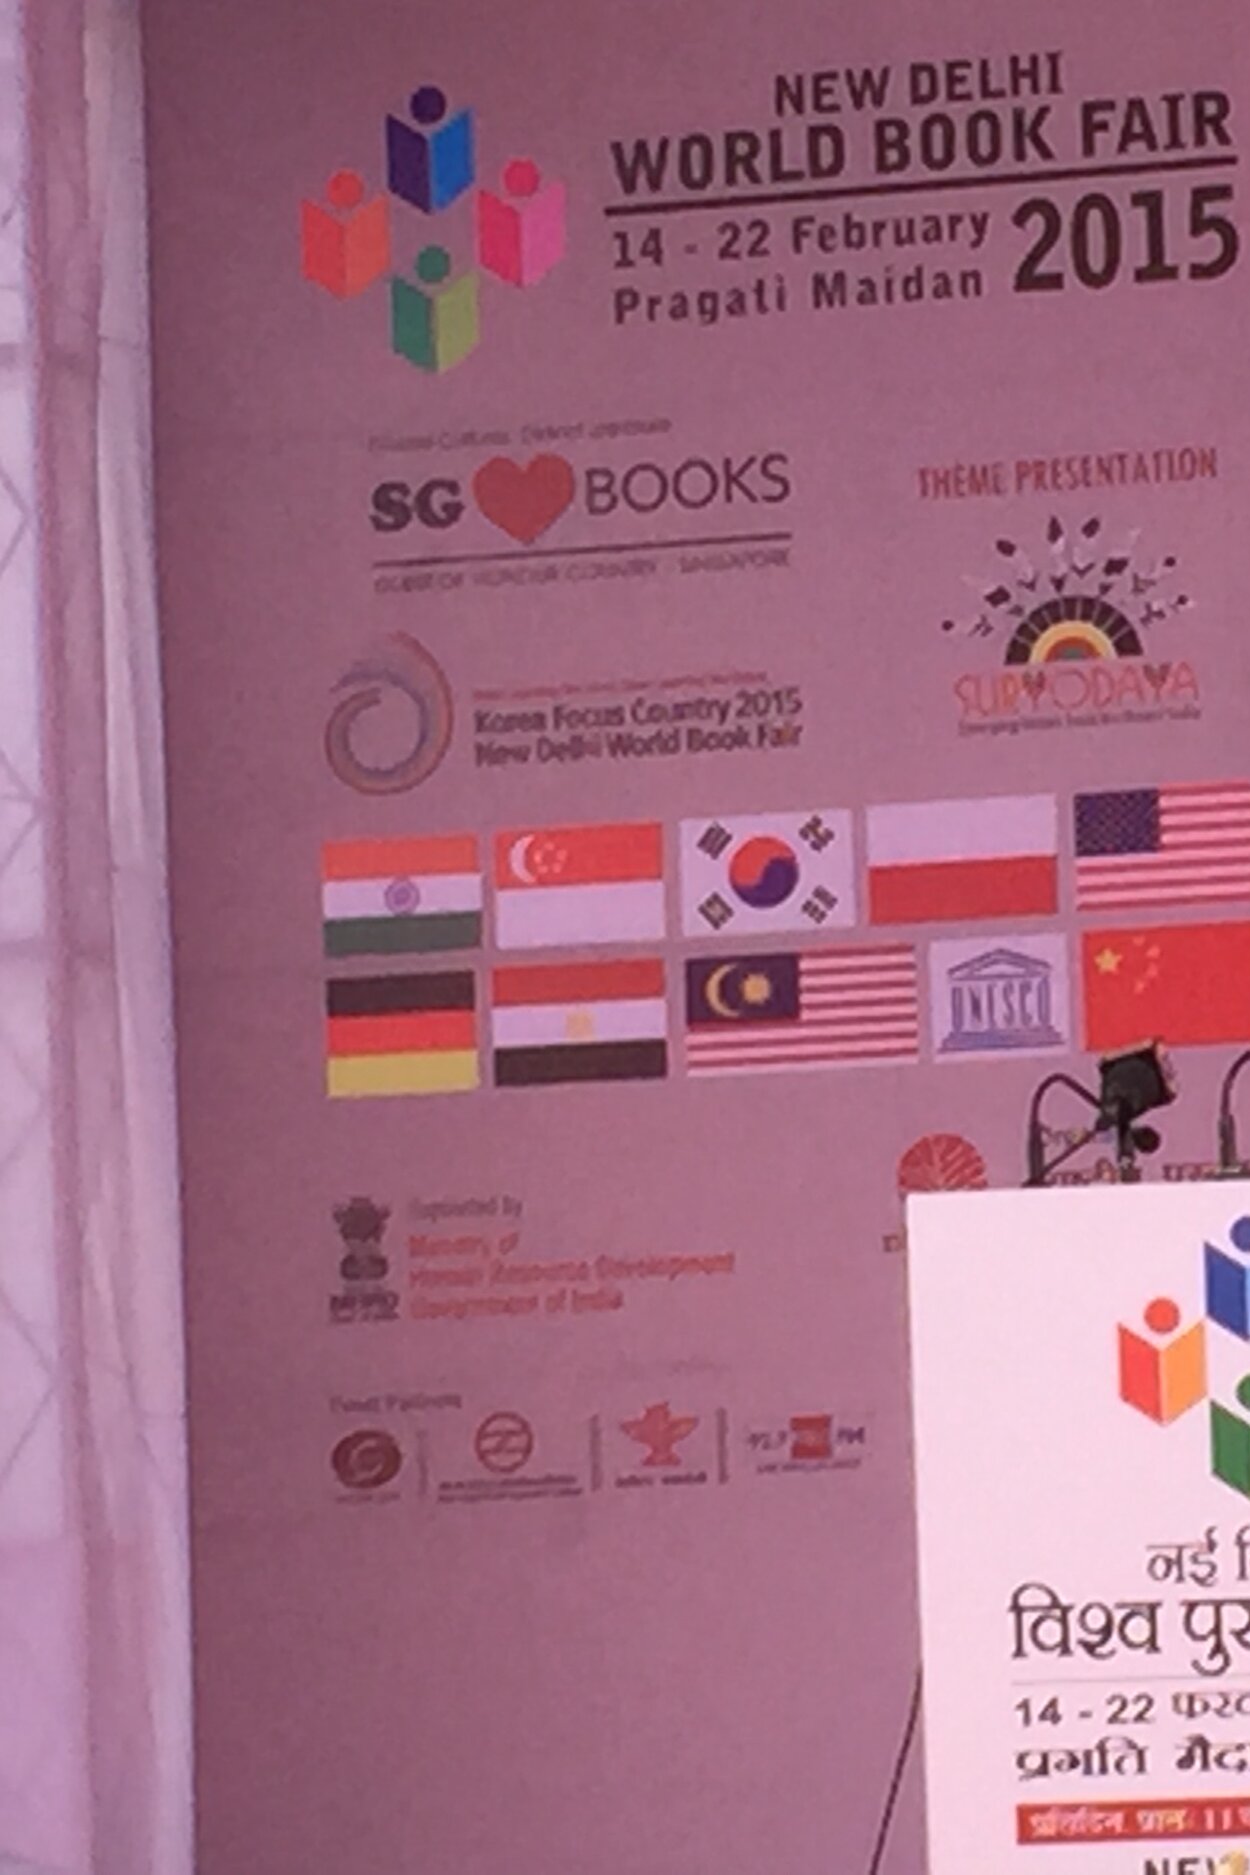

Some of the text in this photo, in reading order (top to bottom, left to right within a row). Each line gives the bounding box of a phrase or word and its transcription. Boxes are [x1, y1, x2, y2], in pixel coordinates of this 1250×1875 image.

[774, 51, 1063, 117] NEW DELHI
[610, 90, 1232, 194] WORLD BOOK FAIR
[613, 227, 664, 268] 14
[717, 219, 771, 259] 22
[791, 210, 991, 256] February
[1011, 183, 1240, 292] 2015
[614, 263, 982, 325] Pragati Maidan
[369, 452, 791, 532] SG BOOKS
[917, 447, 1218, 498] THEME PRESENTATION
[474, 687, 803, 734] Korea Focus Country 2015
[475, 722, 804, 767] New Delhi World Book Fair
[1145, 1526, 1218, 1587] नई
[1008, 1582, 1162, 1660] विश्व
[1015, 1698, 1062, 1728] 14
[1106, 1695, 1155, 1725] 22
[1015, 1736, 1148, 1781] प्रगति
